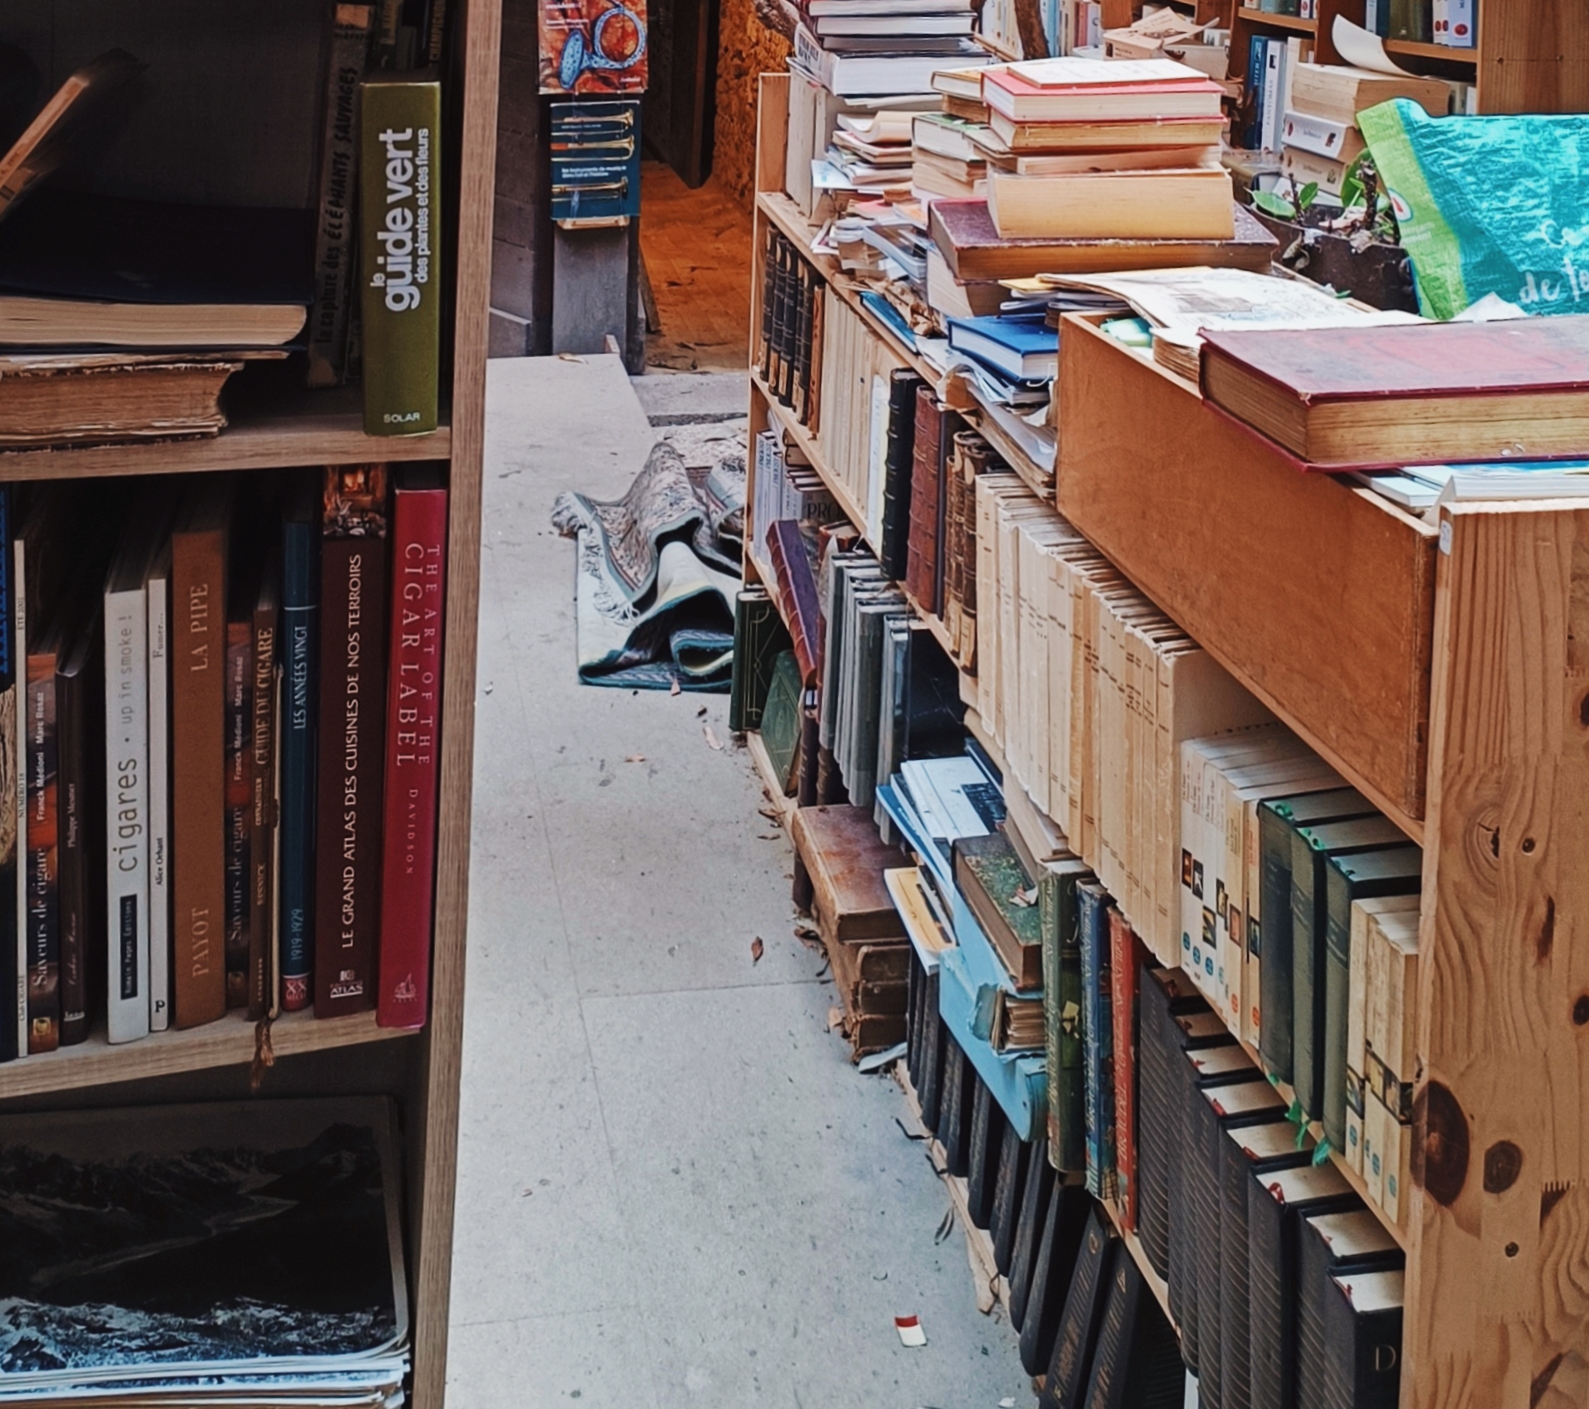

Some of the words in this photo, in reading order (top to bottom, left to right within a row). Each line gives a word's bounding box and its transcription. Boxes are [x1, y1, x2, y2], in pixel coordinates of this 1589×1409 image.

[415, 128, 429, 166] fleurs
[321, 246, 340, 269] des
[338, 67, 358, 142] SAUVAGES
[378, 128, 414, 204] vert
[415, 167, 429, 192] des
[416, 193, 429, 206] et
[415, 208, 431, 256] plantes
[376, 207, 421, 312] guide
[415, 257, 429, 283] des
[370, 273, 385, 287] le
[383, 412, 420, 424] SOLAR
[425, 544, 440, 592] THE
[190, 583, 208, 633] PIPE
[348, 554, 361, 628] TERROIRS
[400, 543, 424, 648] CIGAR
[294, 625, 308, 659] VINGT
[424, 608, 437, 655] ART
[118, 628, 132, 674] smoke
[190, 644, 208, 671] LA
[257, 628, 273, 688] CIGARE
[347, 632, 360, 667] NOS
[118, 681, 131, 698] in
[234, 683, 242, 707] Marc
[290, 662, 307, 706] ANNÉES
[346, 673, 359, 694] DE
[421, 672, 434, 700] OF
[118, 706, 133, 724] up
[256, 694, 272, 714] DU
[293, 709, 306, 729] LES
[396, 663, 420, 767] LABEL
[35, 721, 45, 744] Marc
[255, 718, 271, 765] GUIDE
[345, 699, 358, 771] CUISINES
[419, 716, 433, 764] THE
[35, 751, 46, 787] Médioni
[234, 751, 242, 781] Franck
[36, 790, 45, 820] Franck
[344, 776, 357, 805] DES
[66, 816, 77, 848] Philippe
[113, 758, 141, 872] cigares
[232, 807, 246, 858] cigare
[343, 811, 355, 860] ATLAS
[33, 846, 52, 896] cigare
[155, 867, 163, 886] Alice
[230, 860, 243, 875] de
[32, 898, 47, 918] de
[230, 880, 244, 941] Saveurs
[342, 867, 355, 925] GRAND
[124, 939, 133, 963] Pages
[192, 908, 210, 977] PAYOT
[291, 909, 303, 960] 1919-1929
[342, 930, 355, 948] LE
[31, 924, 48, 986] Saveurs
[124, 966, 132, 994] Romain
[330, 985, 363, 996] ATLAS
